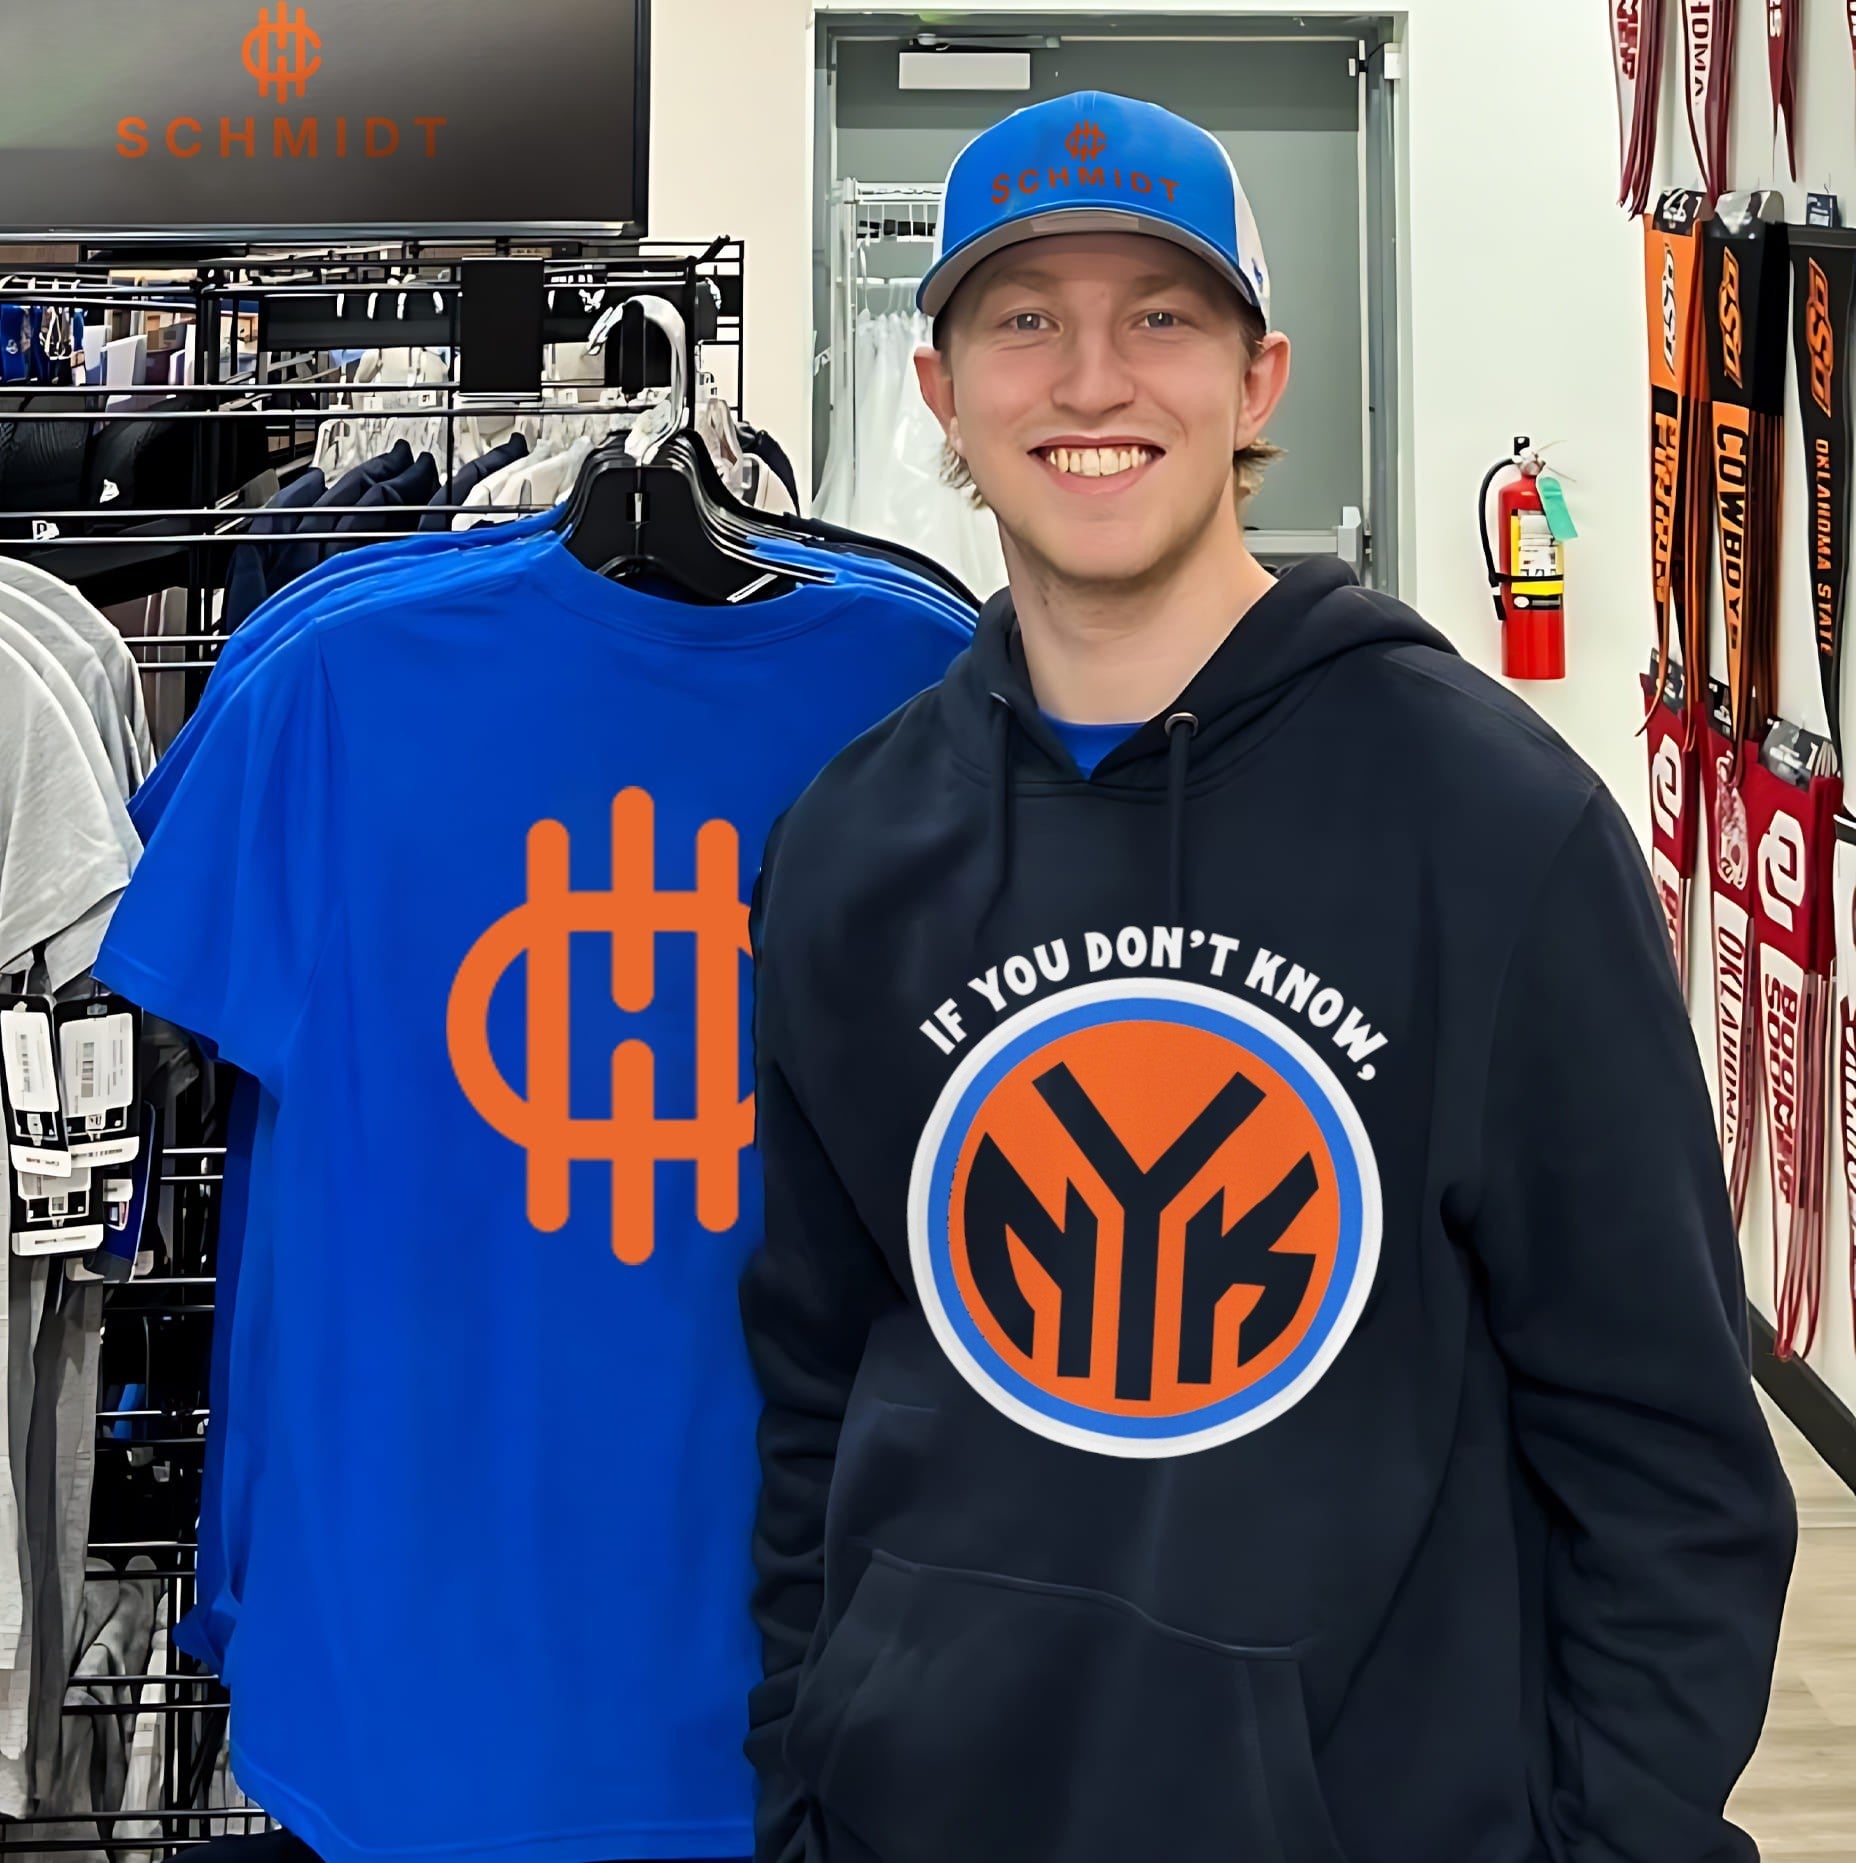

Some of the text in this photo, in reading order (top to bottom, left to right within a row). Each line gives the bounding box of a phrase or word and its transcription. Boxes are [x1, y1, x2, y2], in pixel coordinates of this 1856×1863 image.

[116, 116, 448, 160] SCHMIDT
[991, 166, 1180, 205] SCHMIDT
[919, 926, 1389, 1082] IF YOU DON'T KNOW,
[963, 1060, 1320, 1402] NYK
